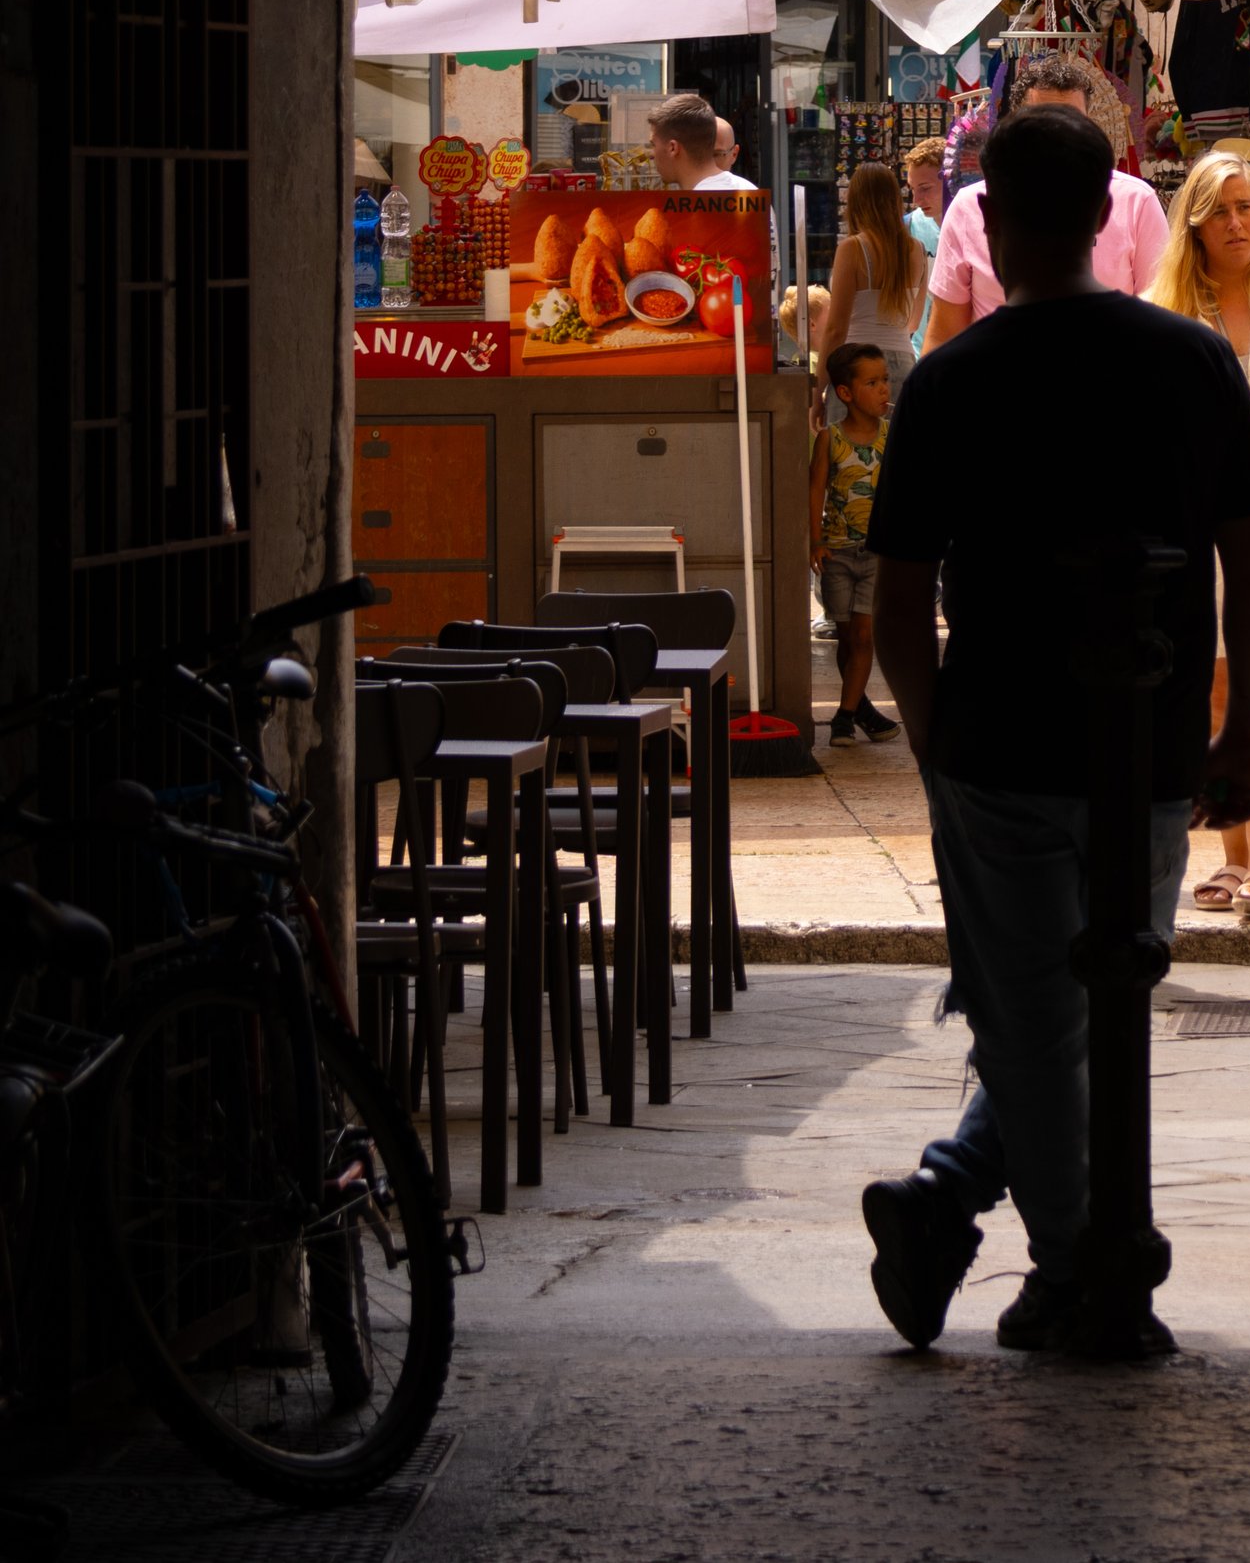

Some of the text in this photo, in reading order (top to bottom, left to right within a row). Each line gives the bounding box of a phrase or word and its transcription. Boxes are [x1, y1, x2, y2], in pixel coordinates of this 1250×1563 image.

[553, 50, 641, 81] Ottica
[430, 151, 469, 166] Chupa
[495, 151, 524, 165] Chupa
[427, 164, 467, 180] Chups
[493, 163, 522, 177] Chups
[664, 196, 766, 213] ARANCINI
